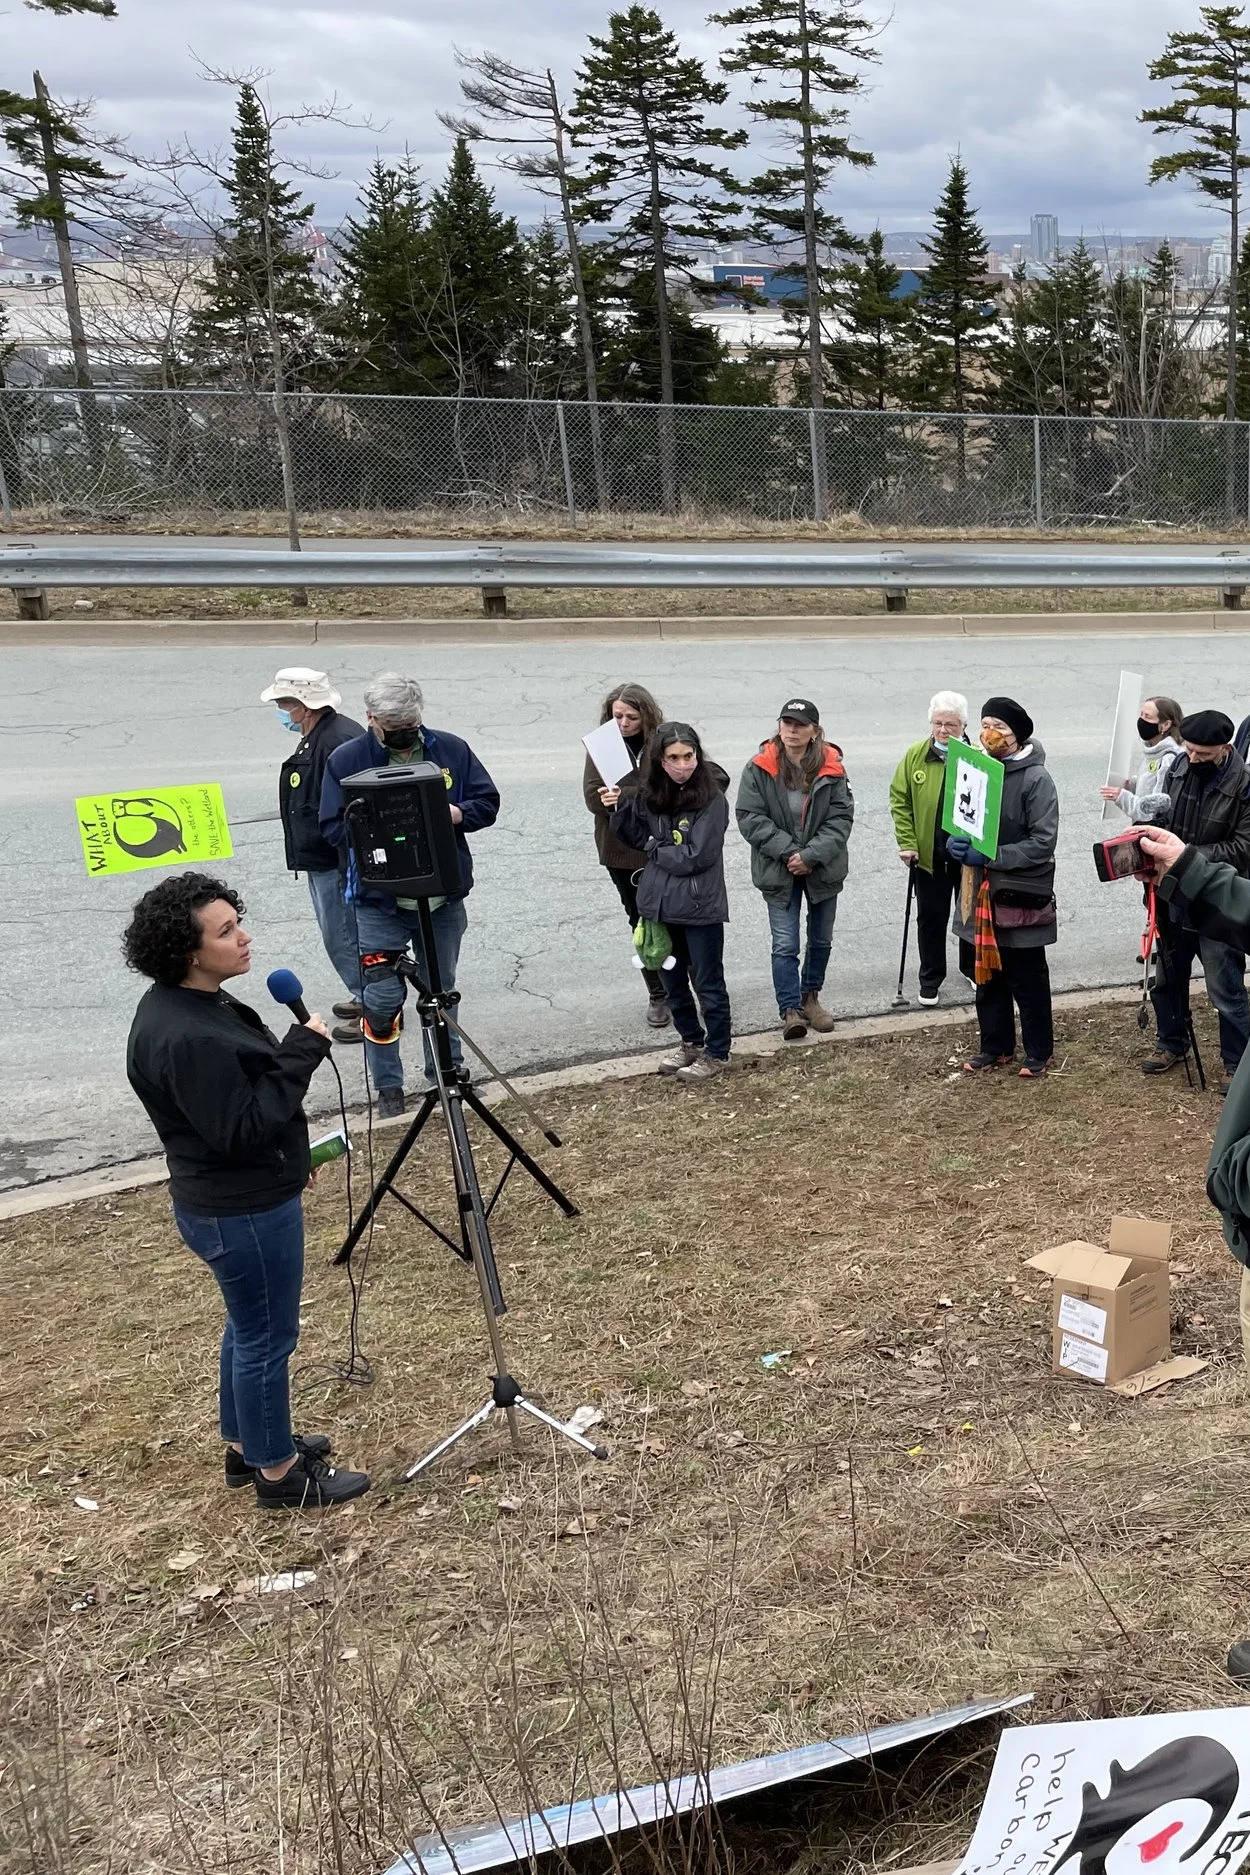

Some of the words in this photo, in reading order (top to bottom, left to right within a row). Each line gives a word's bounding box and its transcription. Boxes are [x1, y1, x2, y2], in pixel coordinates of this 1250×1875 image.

[81, 820, 108, 872] WHAT
[94, 804, 113, 845] ABOUT
[209, 834, 221, 856] SAVE
[1033, 1748, 1076, 1832] help
